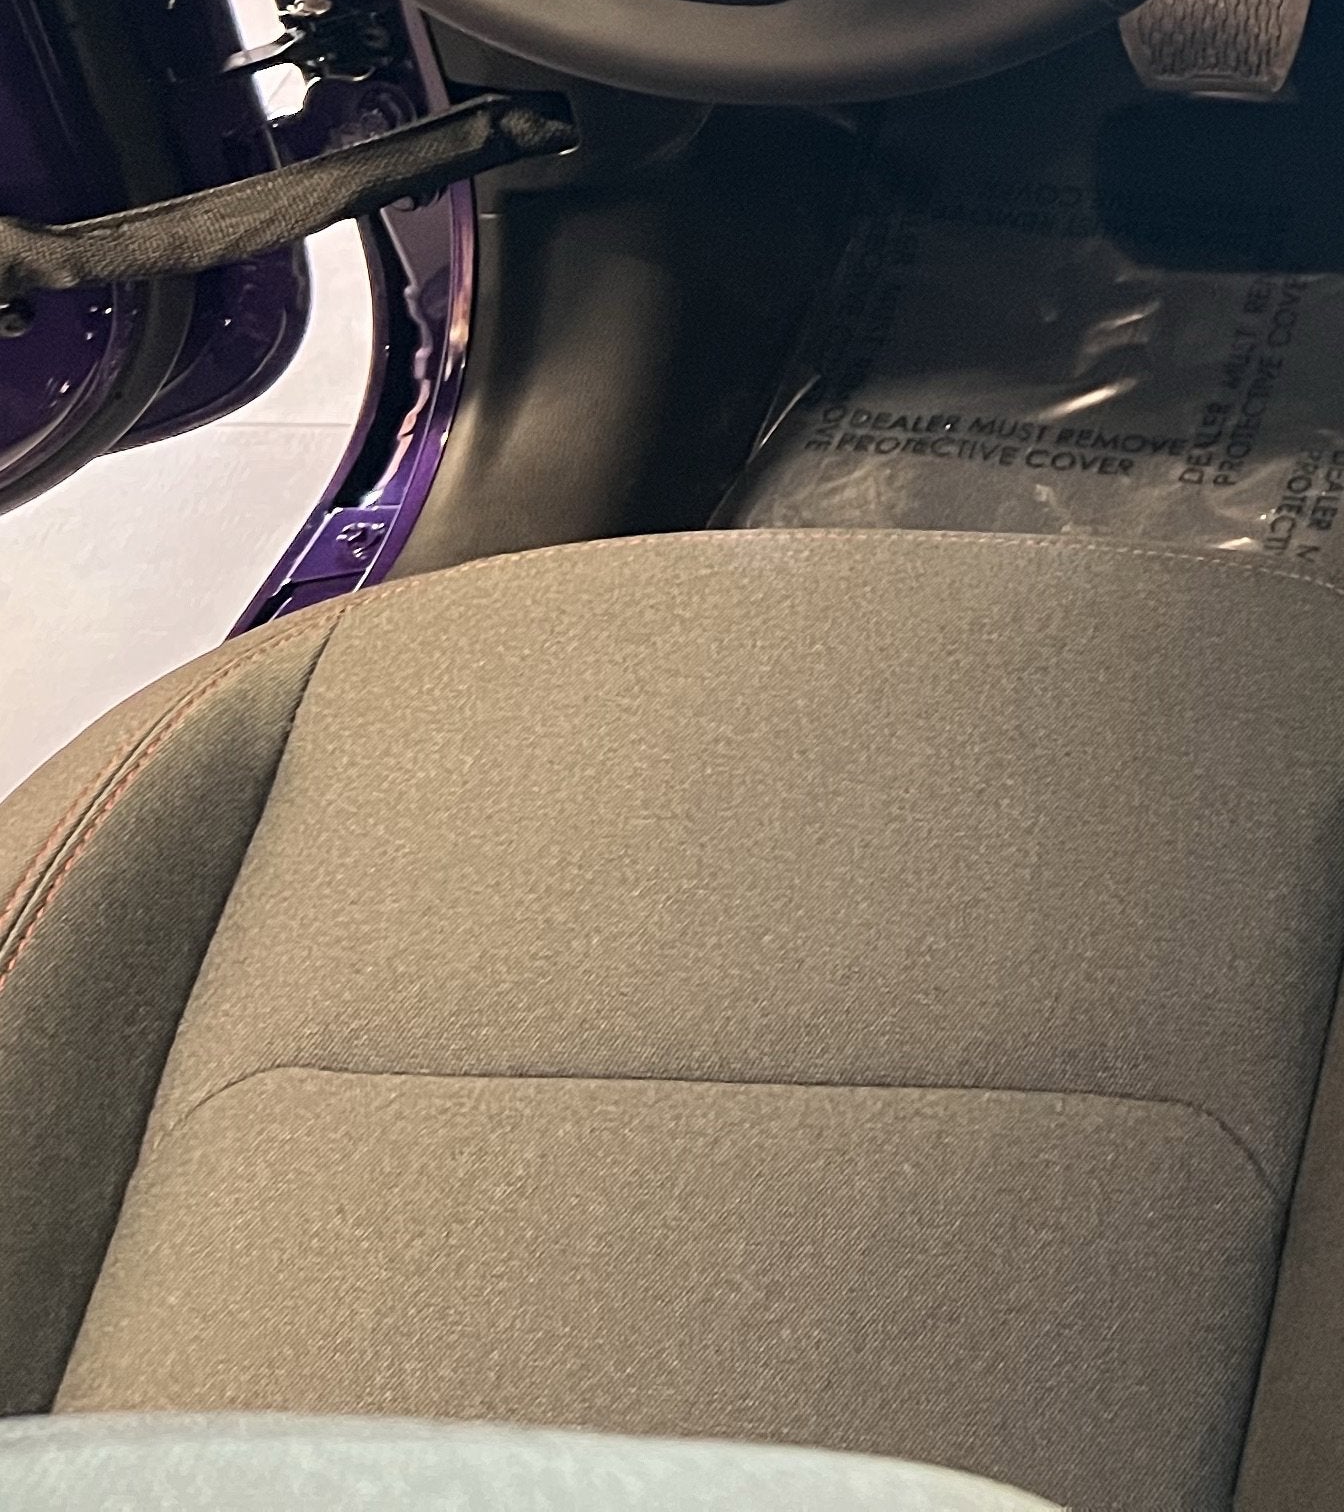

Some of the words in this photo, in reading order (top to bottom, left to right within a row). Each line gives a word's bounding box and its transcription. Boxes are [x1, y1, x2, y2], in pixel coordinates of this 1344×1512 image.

[835, 431, 1016, 466] PROTECTIVE
[1024, 447, 1137, 477] COVER
[850, 406, 962, 436] DEALER
[967, 414, 1047, 444] MUST
[1055, 426, 1190, 458] REMOVE
